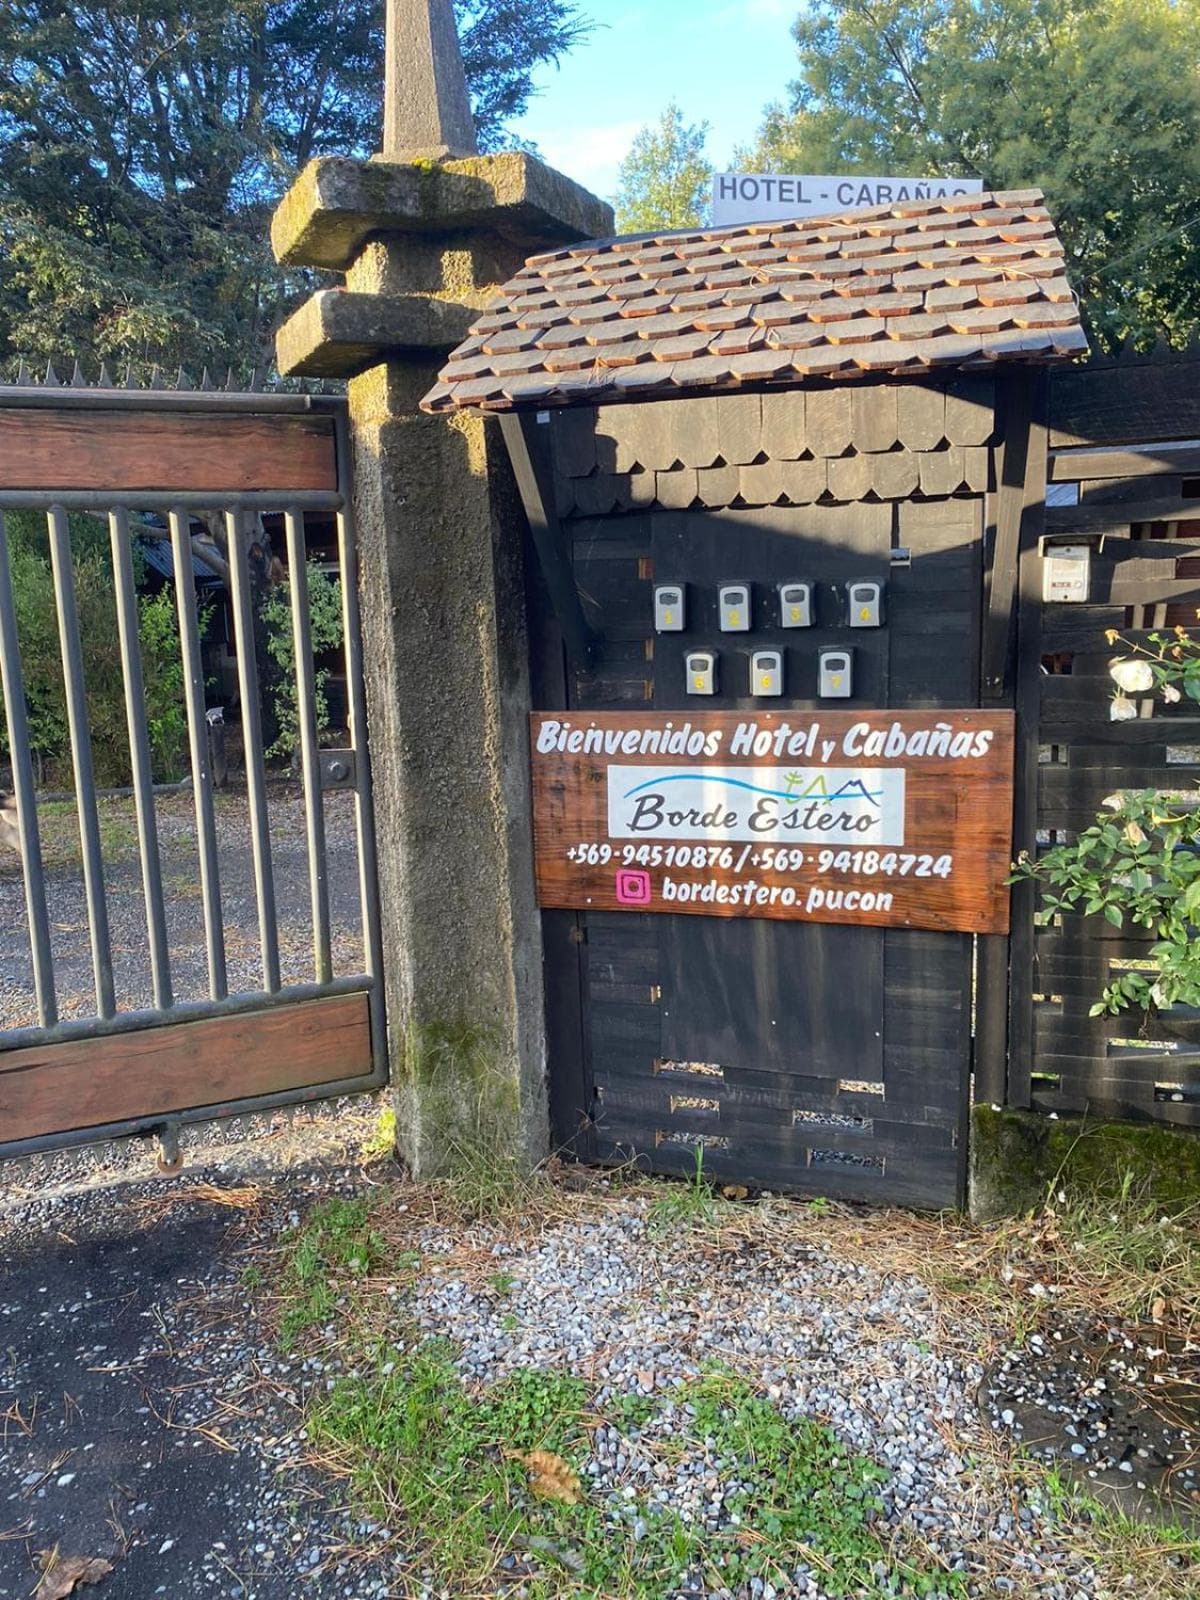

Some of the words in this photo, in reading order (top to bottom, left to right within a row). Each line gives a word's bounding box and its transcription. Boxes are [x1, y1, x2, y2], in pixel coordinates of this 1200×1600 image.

[720, 176, 811, 203] HOTEL
[664, 609, 673, 625] 1
[728, 610, 740, 627] 2
[790, 606, 802, 622] 3
[860, 606, 871, 622] 4
[694, 675, 705, 690] 5
[760, 675, 773, 689] 6
[831, 674, 842, 690] 7
[535, 720, 723, 757] Bienvenidos
[730, 722, 820, 757] Hotel
[822, 739, 836, 763] y
[843, 722, 993, 758] Cabañas
[626, 793, 738, 831] Borde
[748, 797, 880, 832] Estero
